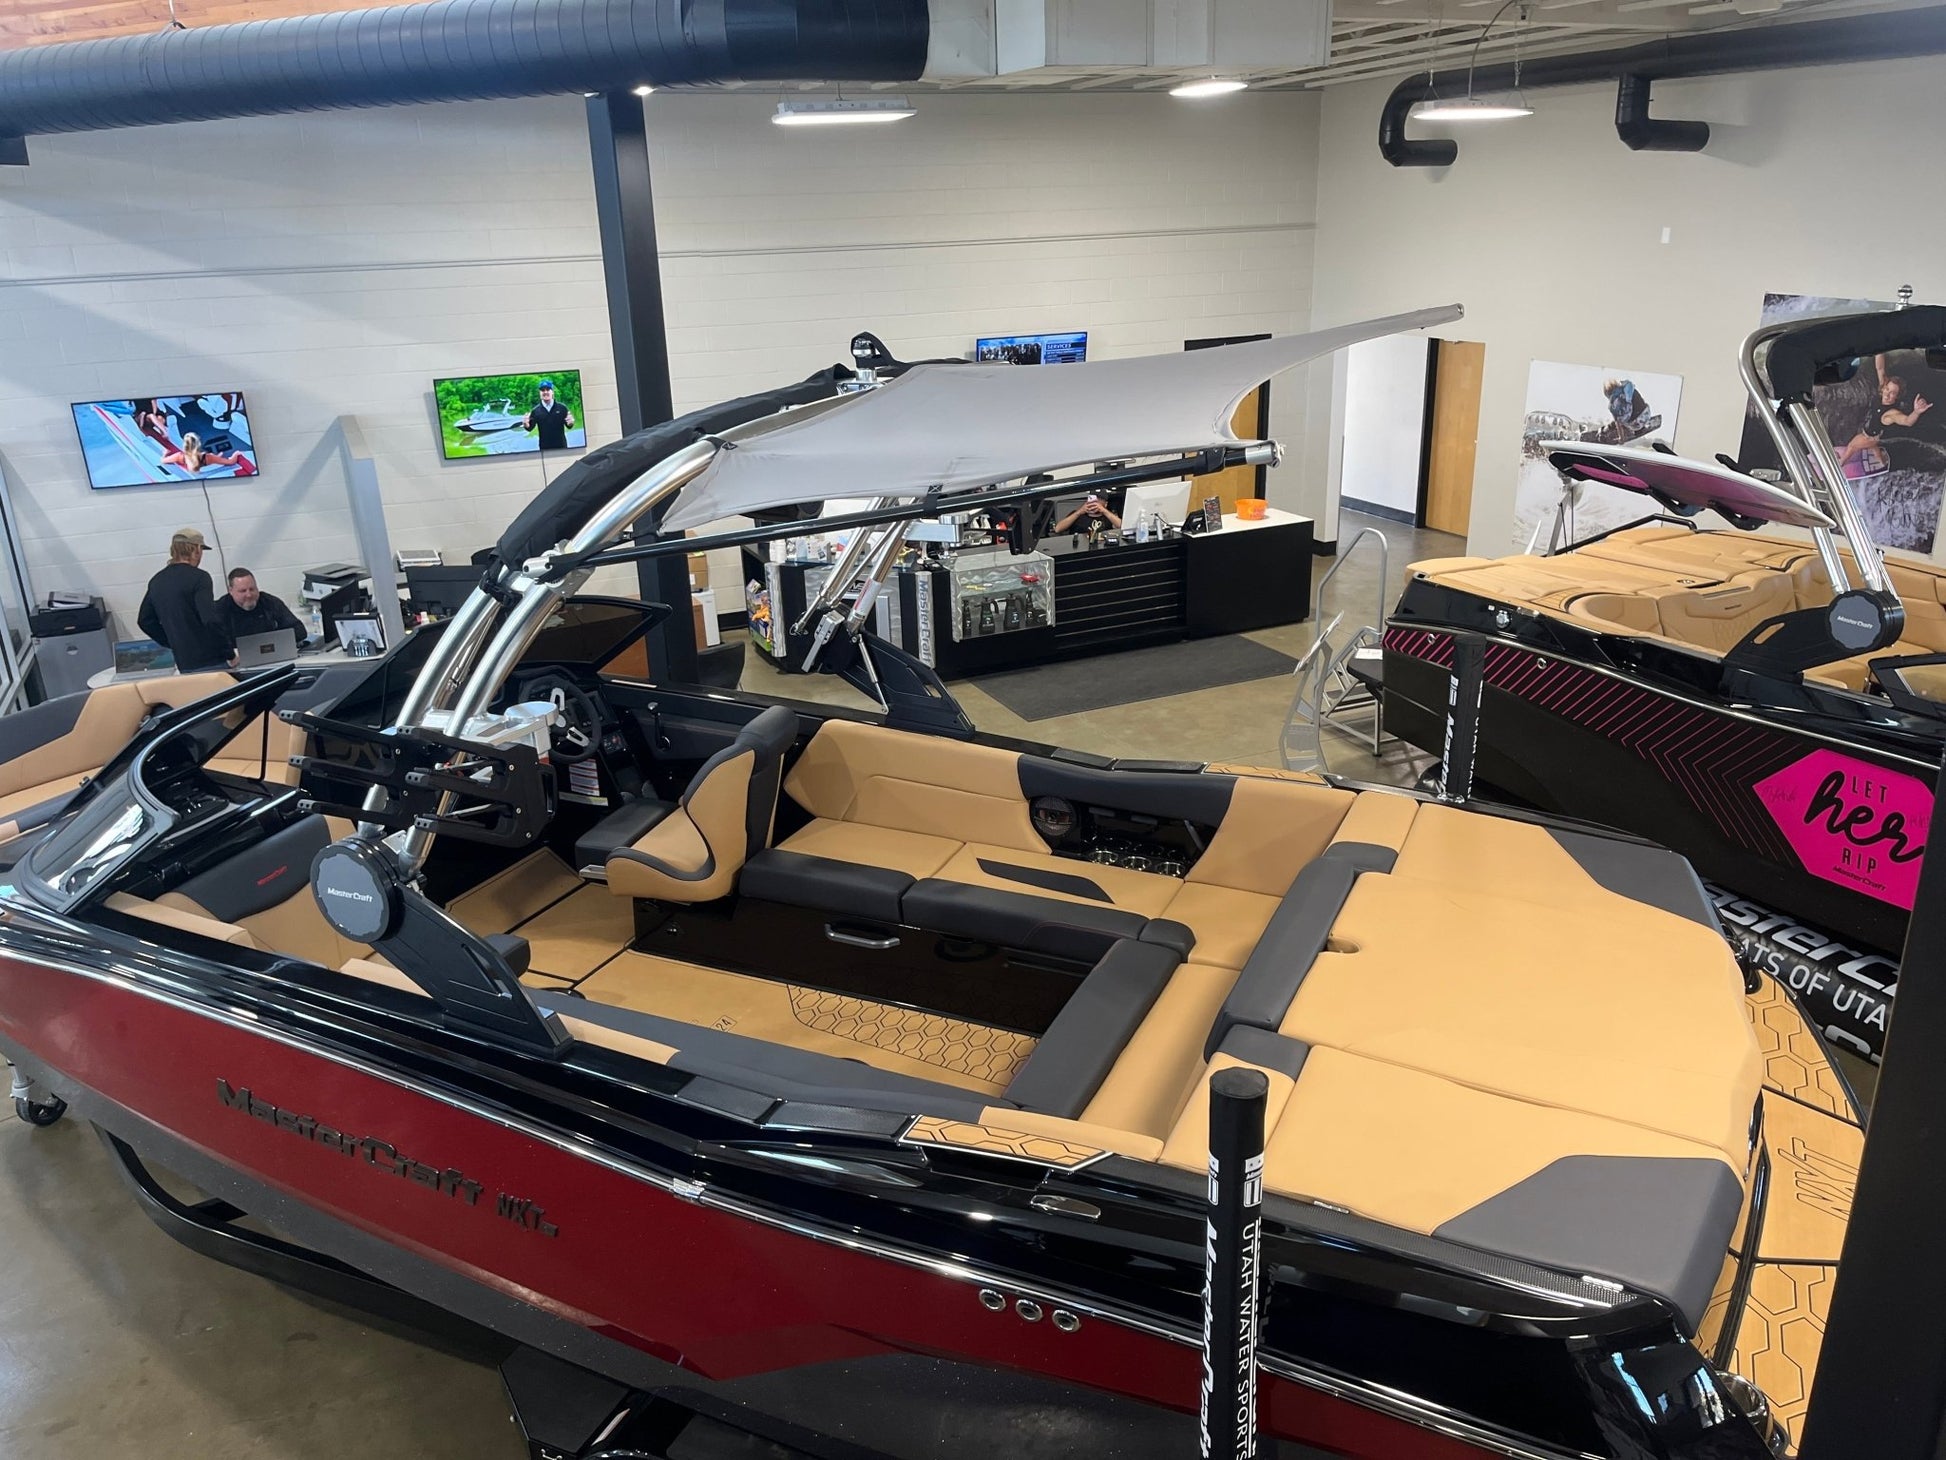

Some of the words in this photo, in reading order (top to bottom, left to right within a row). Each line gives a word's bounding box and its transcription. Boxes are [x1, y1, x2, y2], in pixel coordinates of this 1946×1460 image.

[1852, 776, 1887, 803] LET
[1804, 770, 1925, 863] her
[1841, 847, 1877, 873] RIP
[327, 887, 373, 902] MasterCraft
[1789, 964, 1831, 996] OF
[216, 1077, 484, 1206] MasterCraft
[1240, 1222, 1255, 1289] UTAH
[1238, 1295, 1252, 1375] WATER
